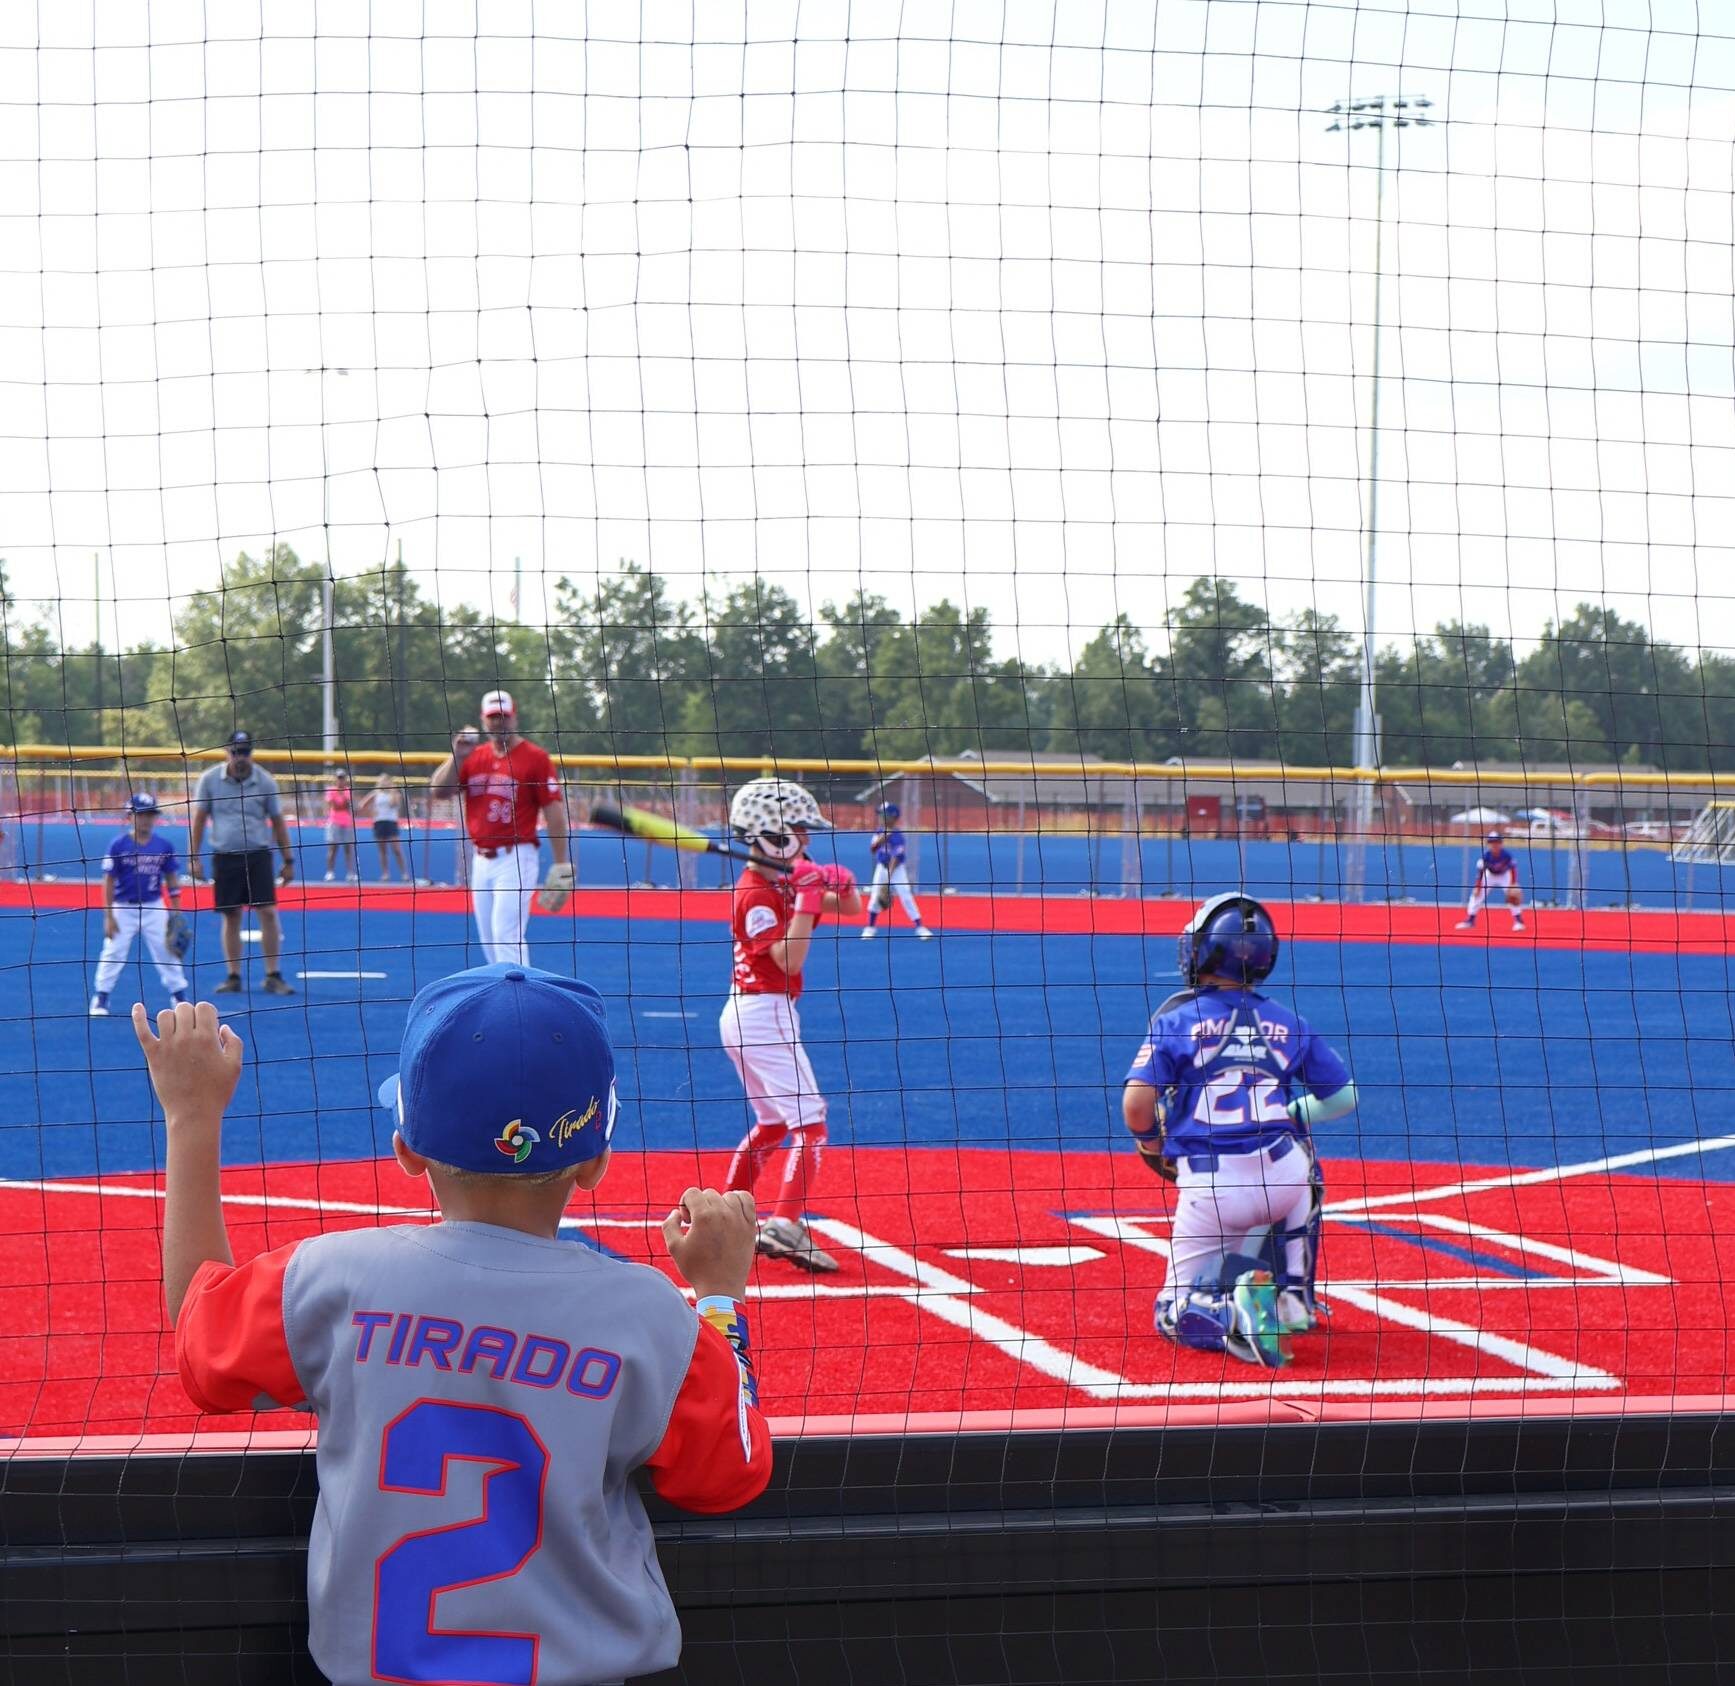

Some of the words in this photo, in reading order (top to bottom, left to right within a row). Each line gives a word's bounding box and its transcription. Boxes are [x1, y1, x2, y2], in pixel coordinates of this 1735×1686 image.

[1191, 1018, 1290, 1044] AMOR
[549, 1095, 600, 1148] Tirado
[1193, 1047, 1290, 1125] 22
[352, 1311, 622, 1400] TIRADO
[371, 1397, 551, 1686] 2
